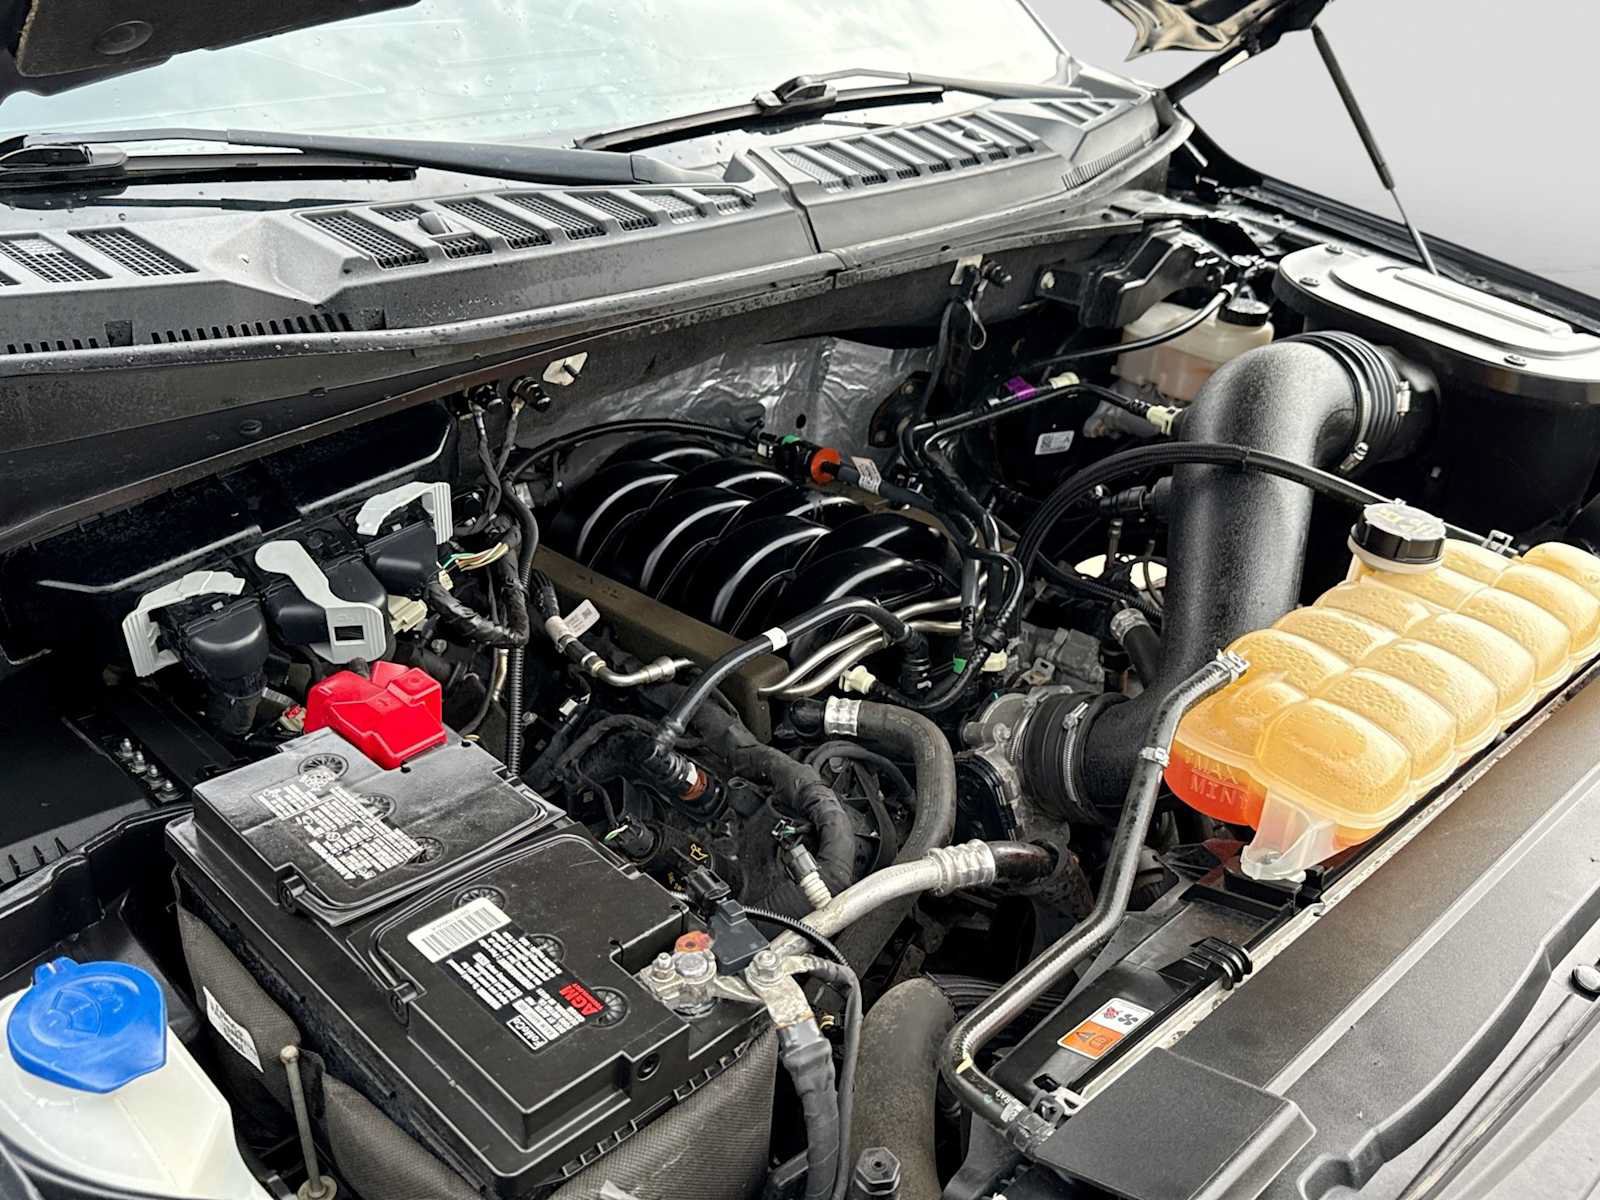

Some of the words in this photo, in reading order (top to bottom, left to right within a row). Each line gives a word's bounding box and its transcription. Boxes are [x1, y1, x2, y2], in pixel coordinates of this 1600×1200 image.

[1193, 756, 1238, 785] MAX
[1190, 775, 1237, 805] MIN
[560, 985, 599, 1017] AGM
[514, 1018, 546, 1048] FoMoCo
